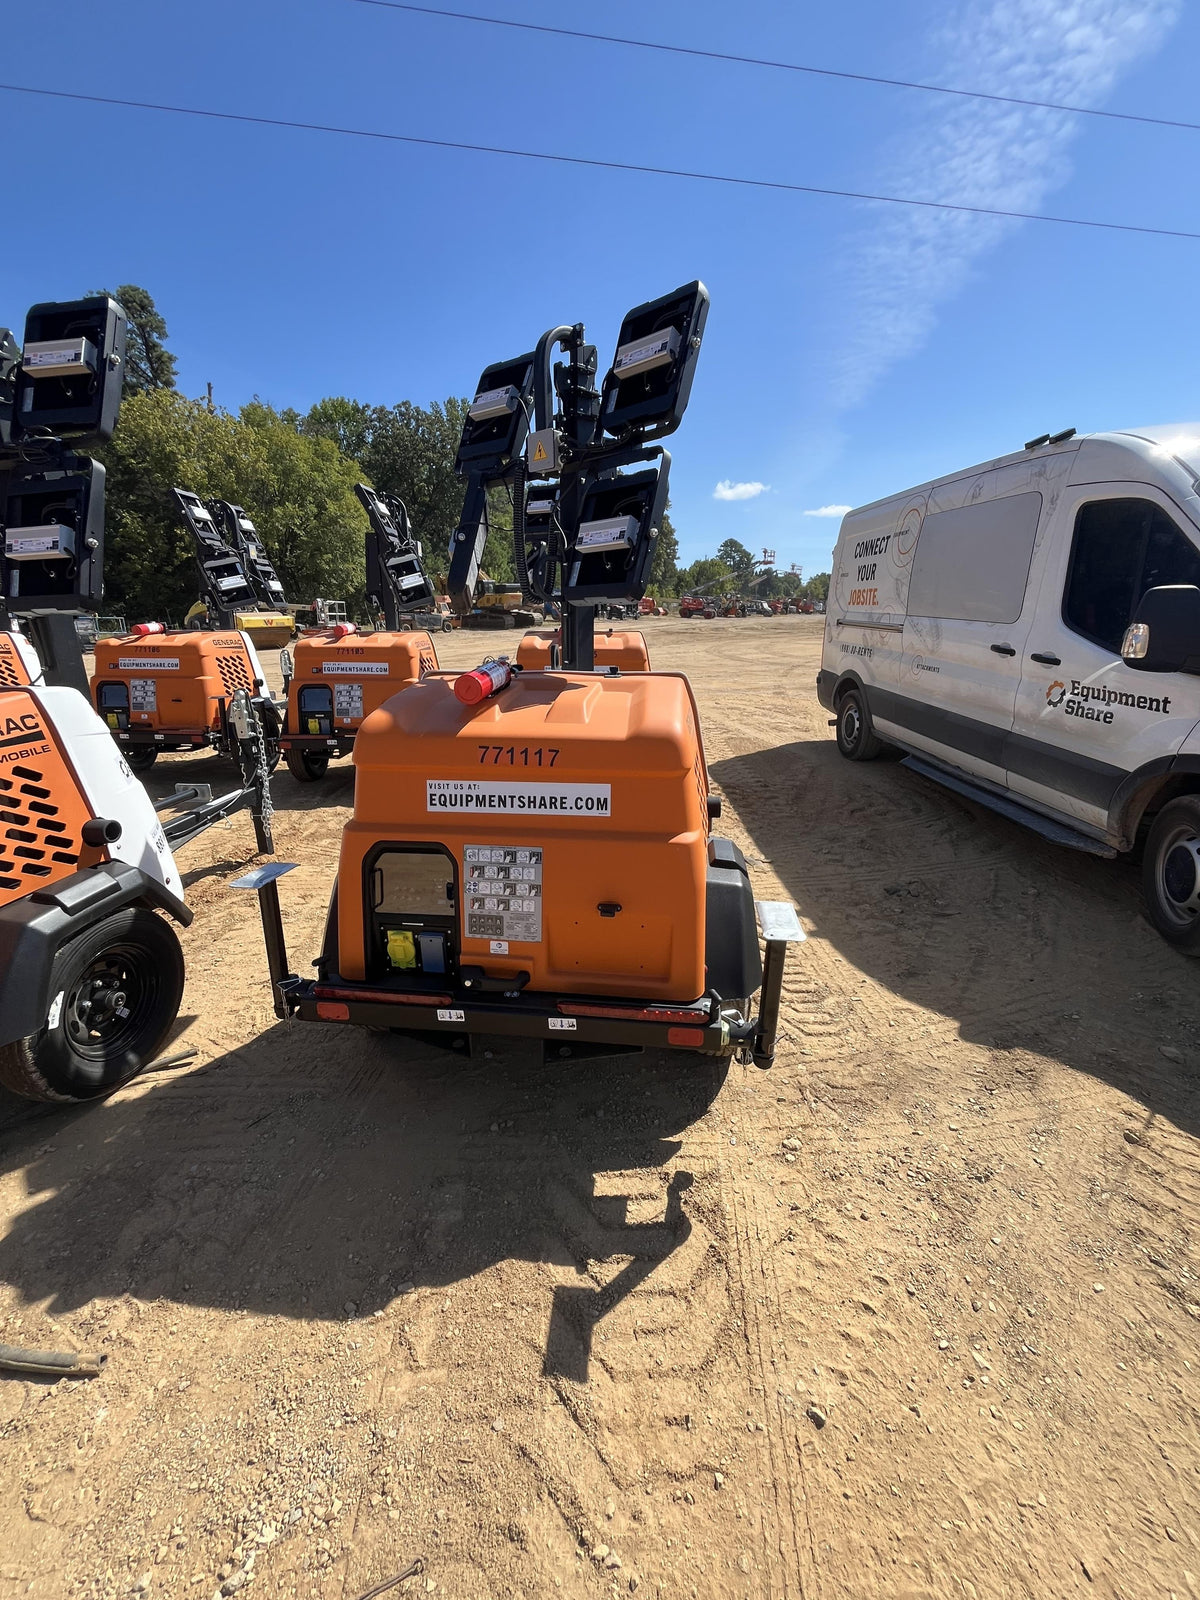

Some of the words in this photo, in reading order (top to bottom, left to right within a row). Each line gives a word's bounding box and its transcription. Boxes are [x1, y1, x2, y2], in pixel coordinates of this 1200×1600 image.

[854, 535, 892, 559] CONNECT
[857, 563, 877, 582] YOUR
[848, 588, 879, 606] JOBSITE.
[1070, 680, 1171, 714] Equipment
[1064, 699, 1114, 724] Share
[478, 745, 560, 767] 771117
[453, 783, 464, 791] US
[429, 793, 608, 811] EQUIPMENTSHARE.COM
